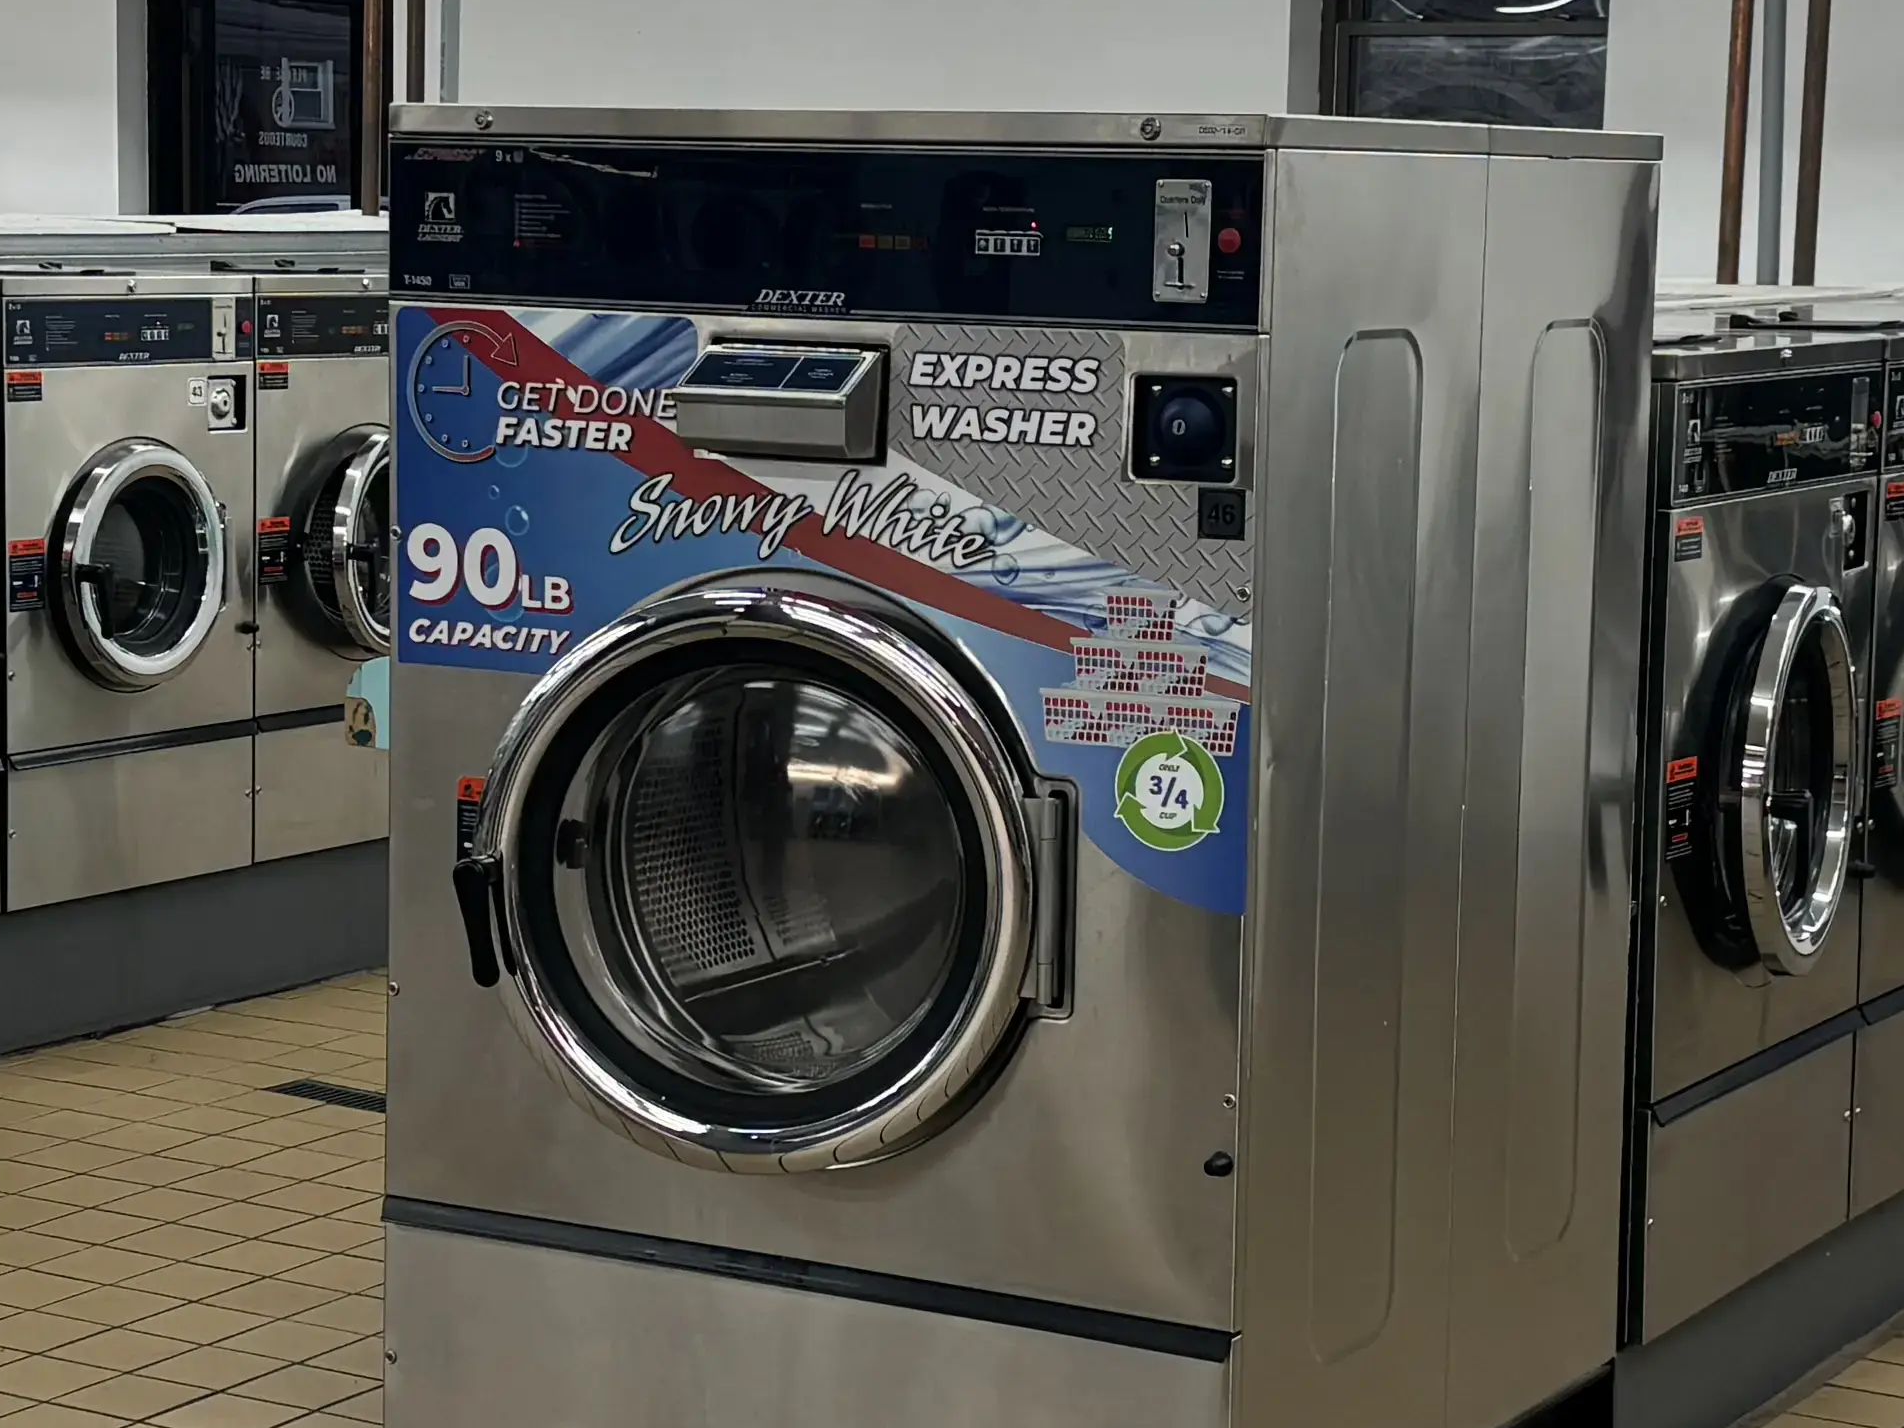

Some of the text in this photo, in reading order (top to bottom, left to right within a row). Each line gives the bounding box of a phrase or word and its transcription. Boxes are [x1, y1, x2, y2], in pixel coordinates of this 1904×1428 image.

[755, 289, 846, 307] DEXTER
[909, 352, 1101, 393] EXPRESS
[497, 379, 677, 418] GET DONE
[496, 416, 633, 452] FASTER
[910, 404, 1097, 448] WASHER
[609, 468, 996, 568] Snowy White
[1206, 502, 1236, 525] 46
[407, 523, 574, 614] 90 LB
[408, 618, 572, 655] CAPACITY
[1149, 775, 1189, 809] 3/4
